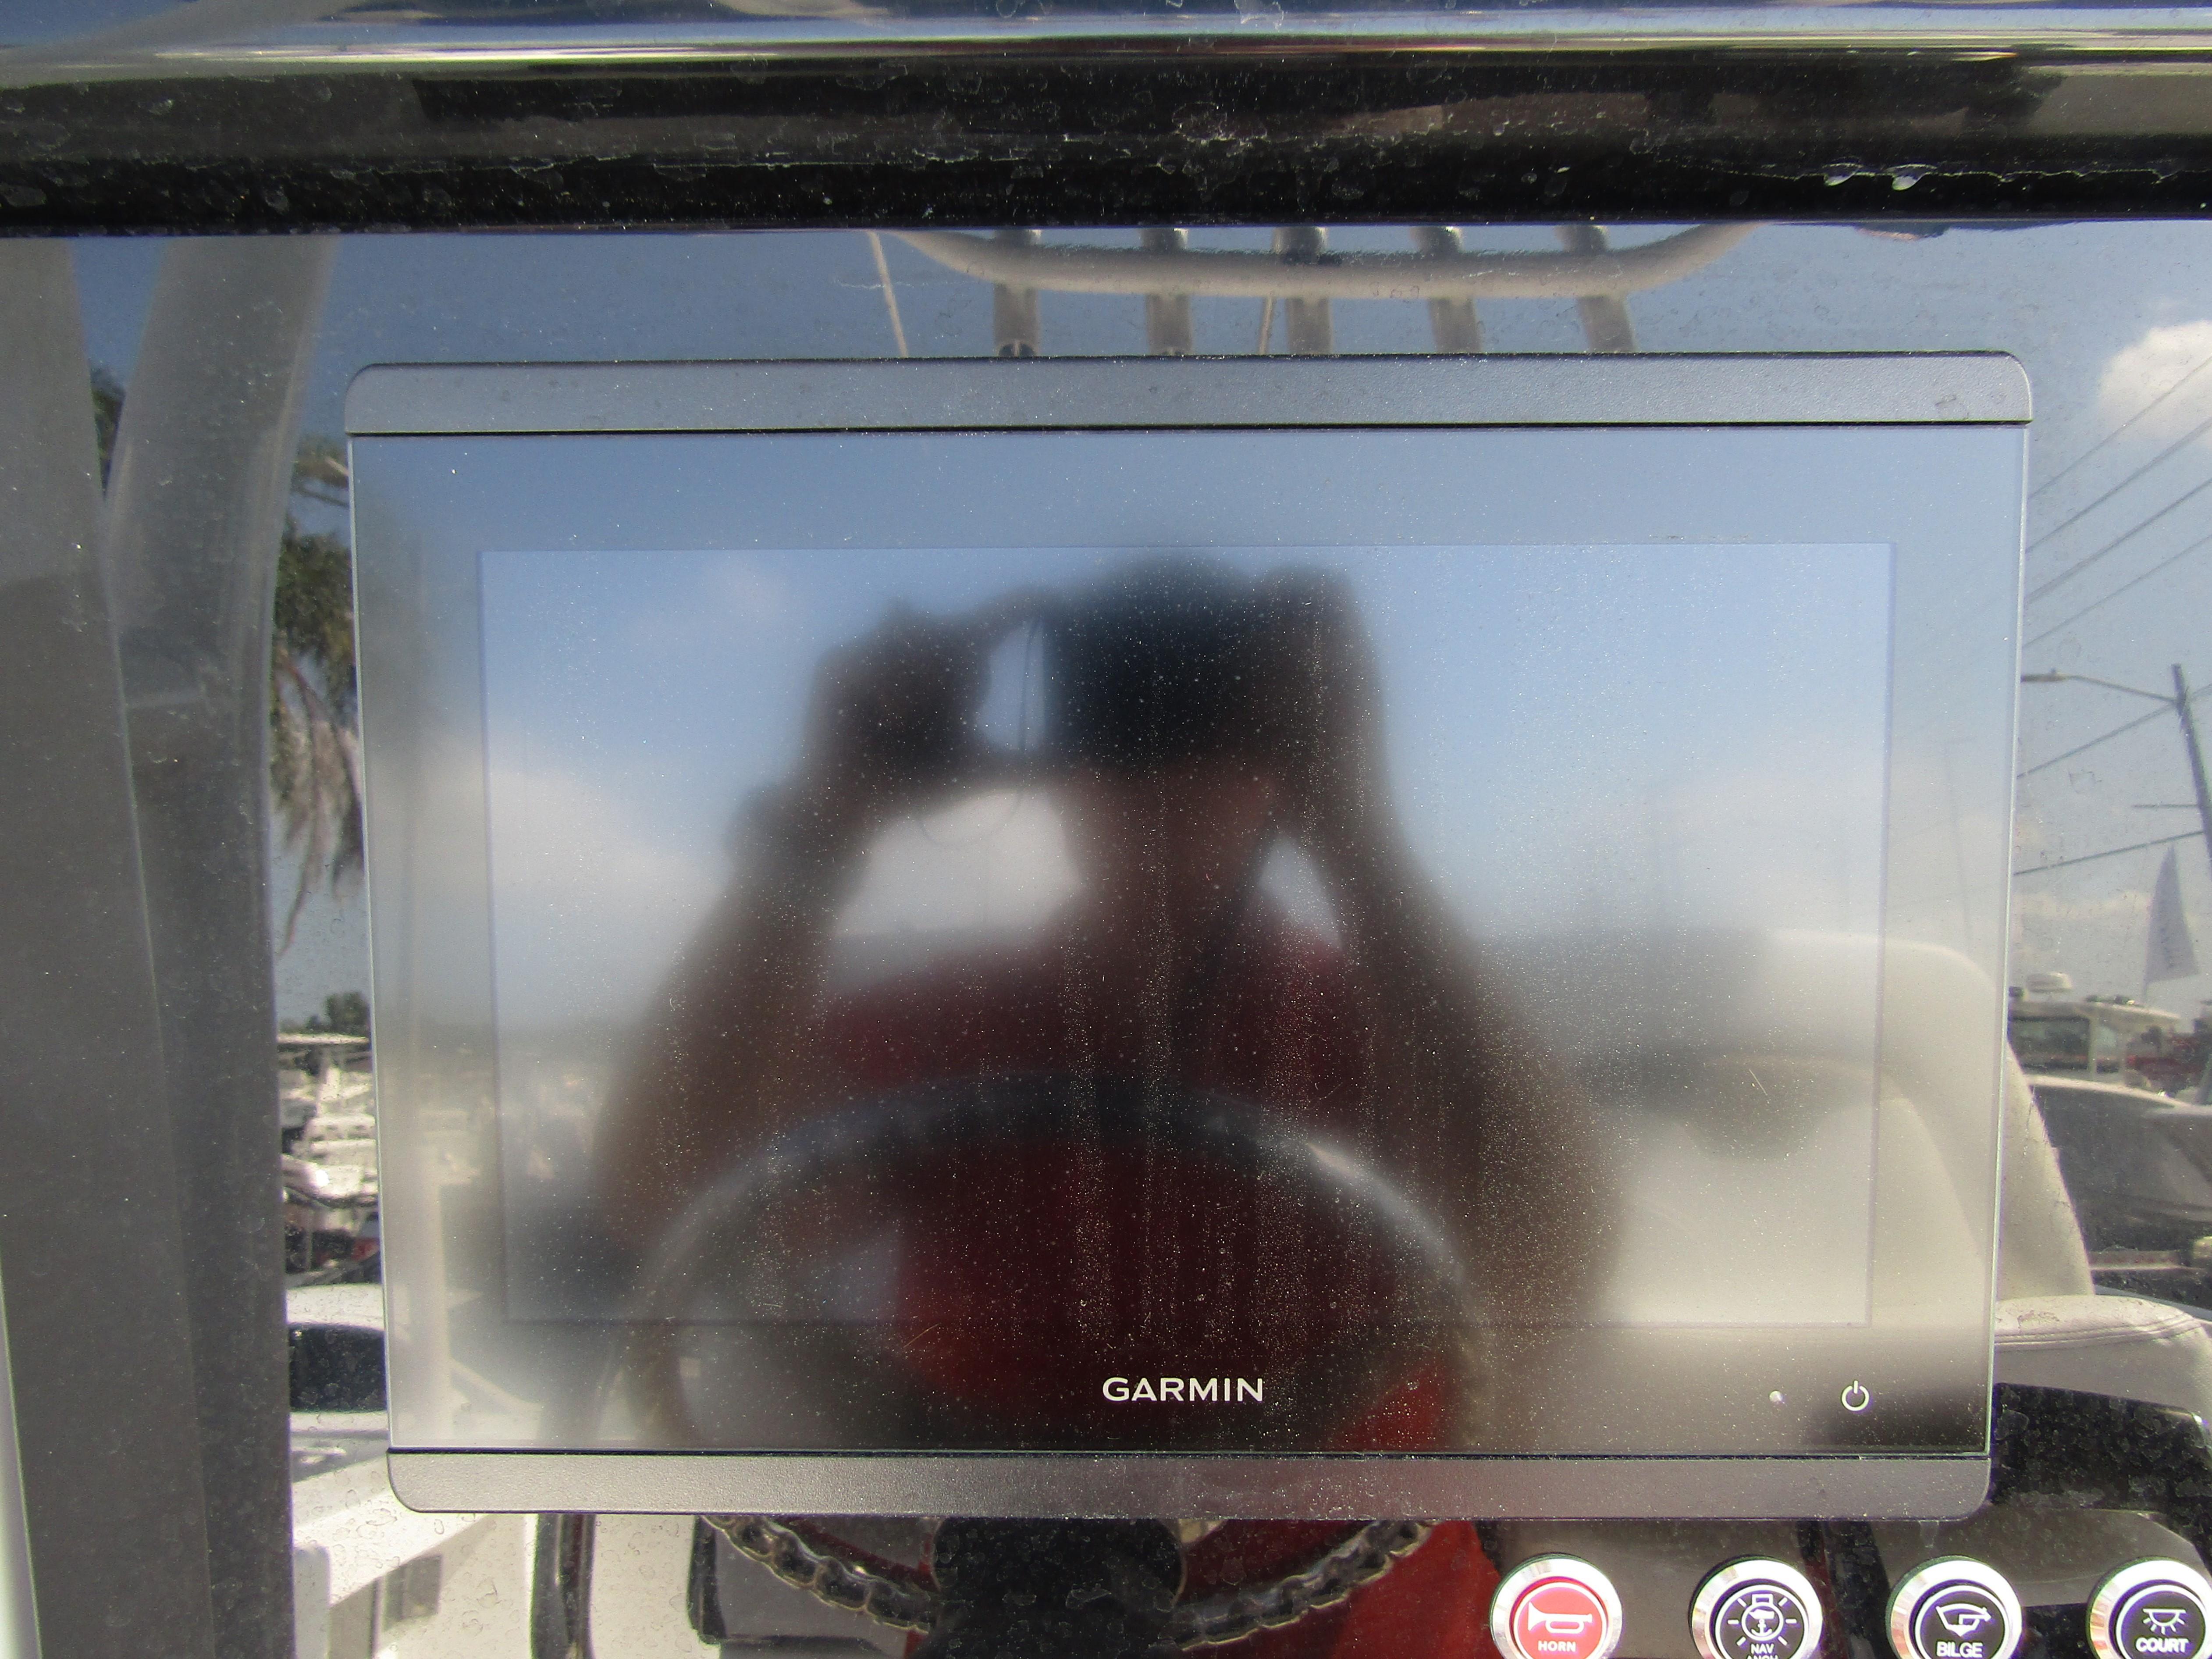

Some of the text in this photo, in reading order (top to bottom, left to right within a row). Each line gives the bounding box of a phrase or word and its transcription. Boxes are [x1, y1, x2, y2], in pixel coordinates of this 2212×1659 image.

[1102, 1377, 1263, 1402] GARMIN
[1537, 1640, 1576, 1652] HORN
[1750, 1643, 1775, 1654] NAV
[1936, 1641, 1984, 1658] BILGE
[2135, 1637, 2189, 1653] COURT
